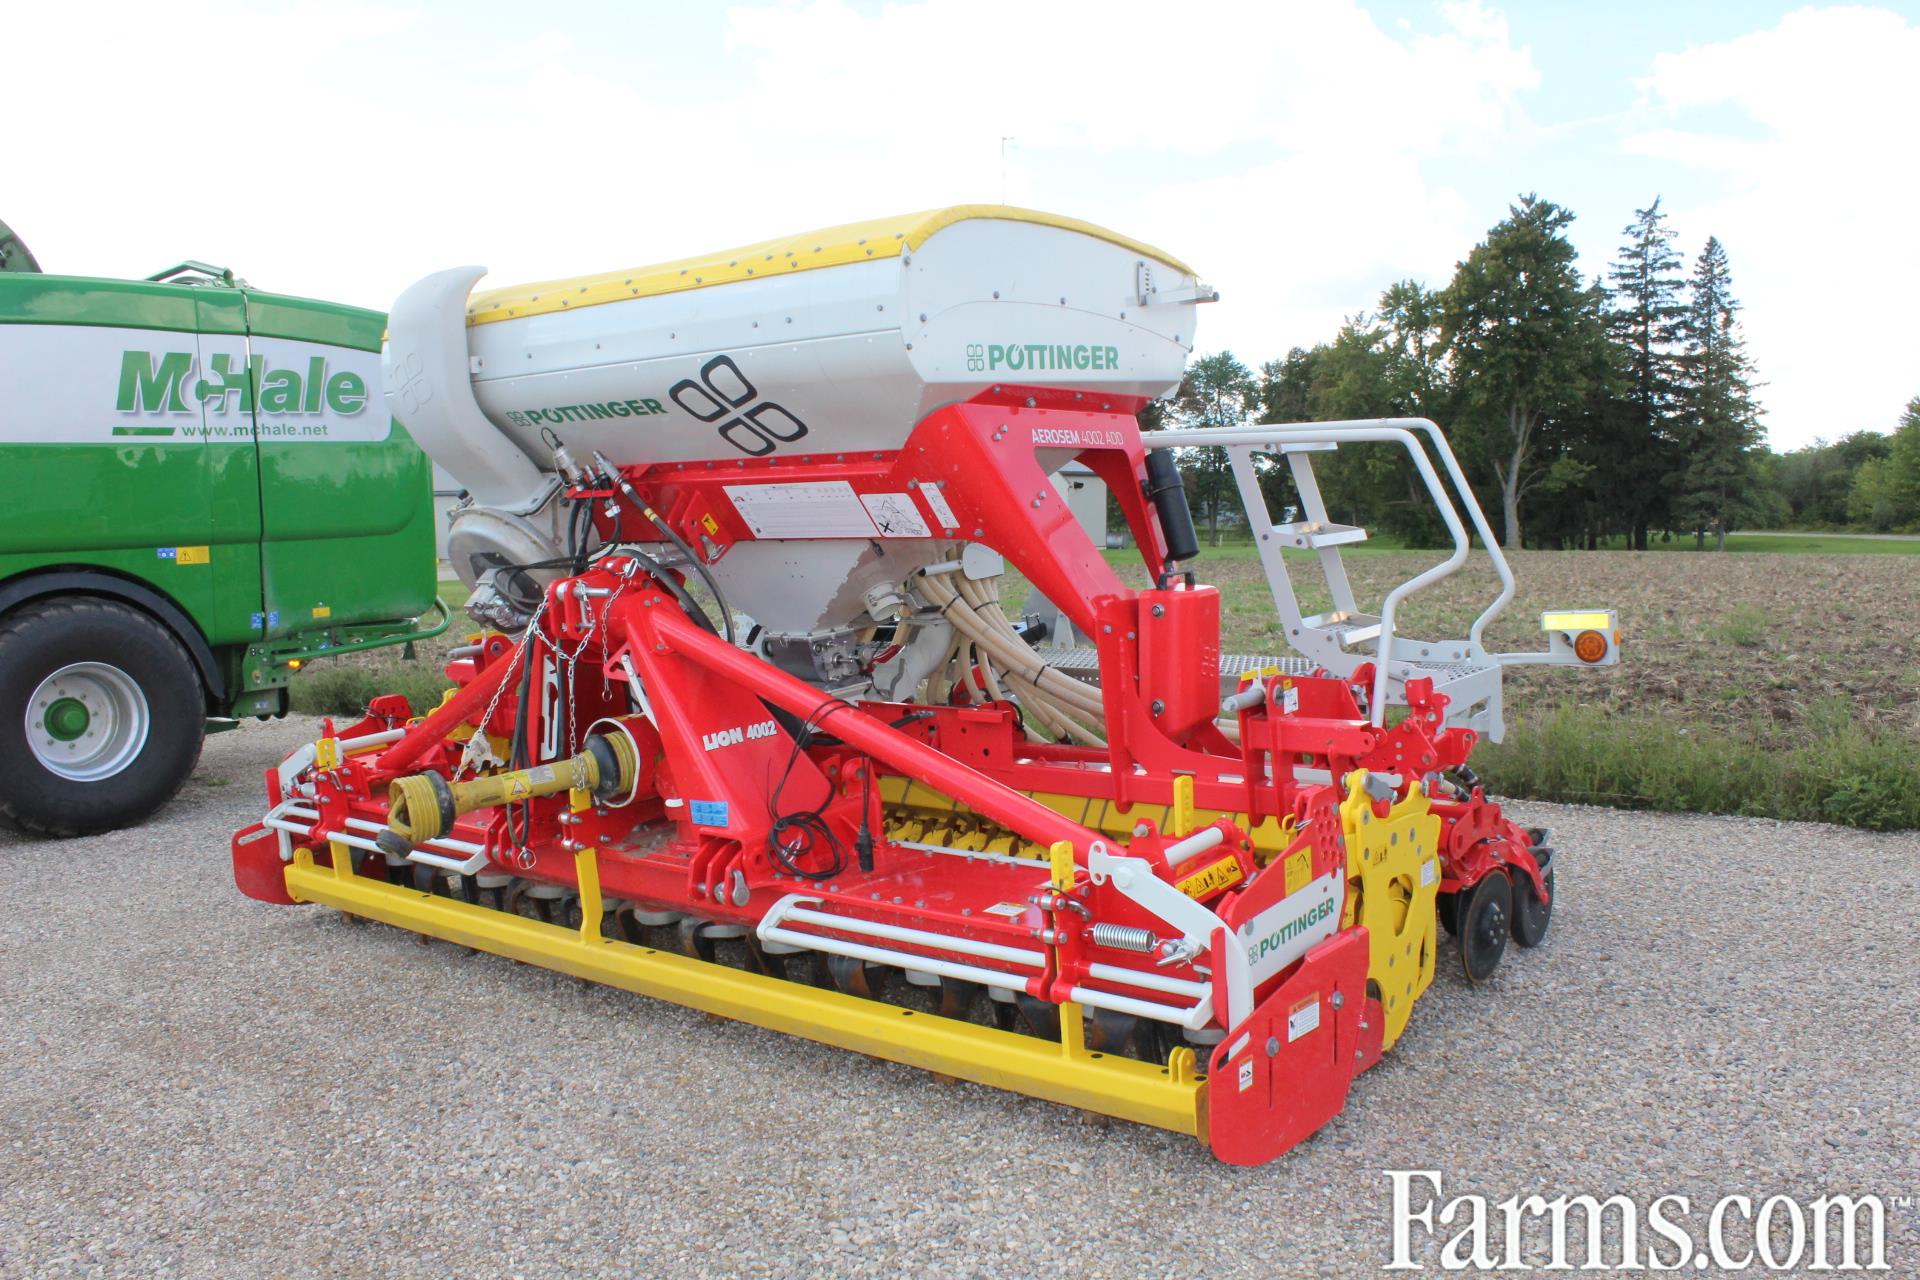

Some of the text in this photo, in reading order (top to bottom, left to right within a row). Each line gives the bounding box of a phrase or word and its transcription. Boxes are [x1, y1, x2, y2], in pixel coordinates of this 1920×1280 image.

[116, 350, 367, 414] McHale
[181, 423, 329, 436] www.mchale.net
[1032, 428, 1124, 445] AEROSEM 4002 ADD
[702, 720, 777, 751] LION 4002
